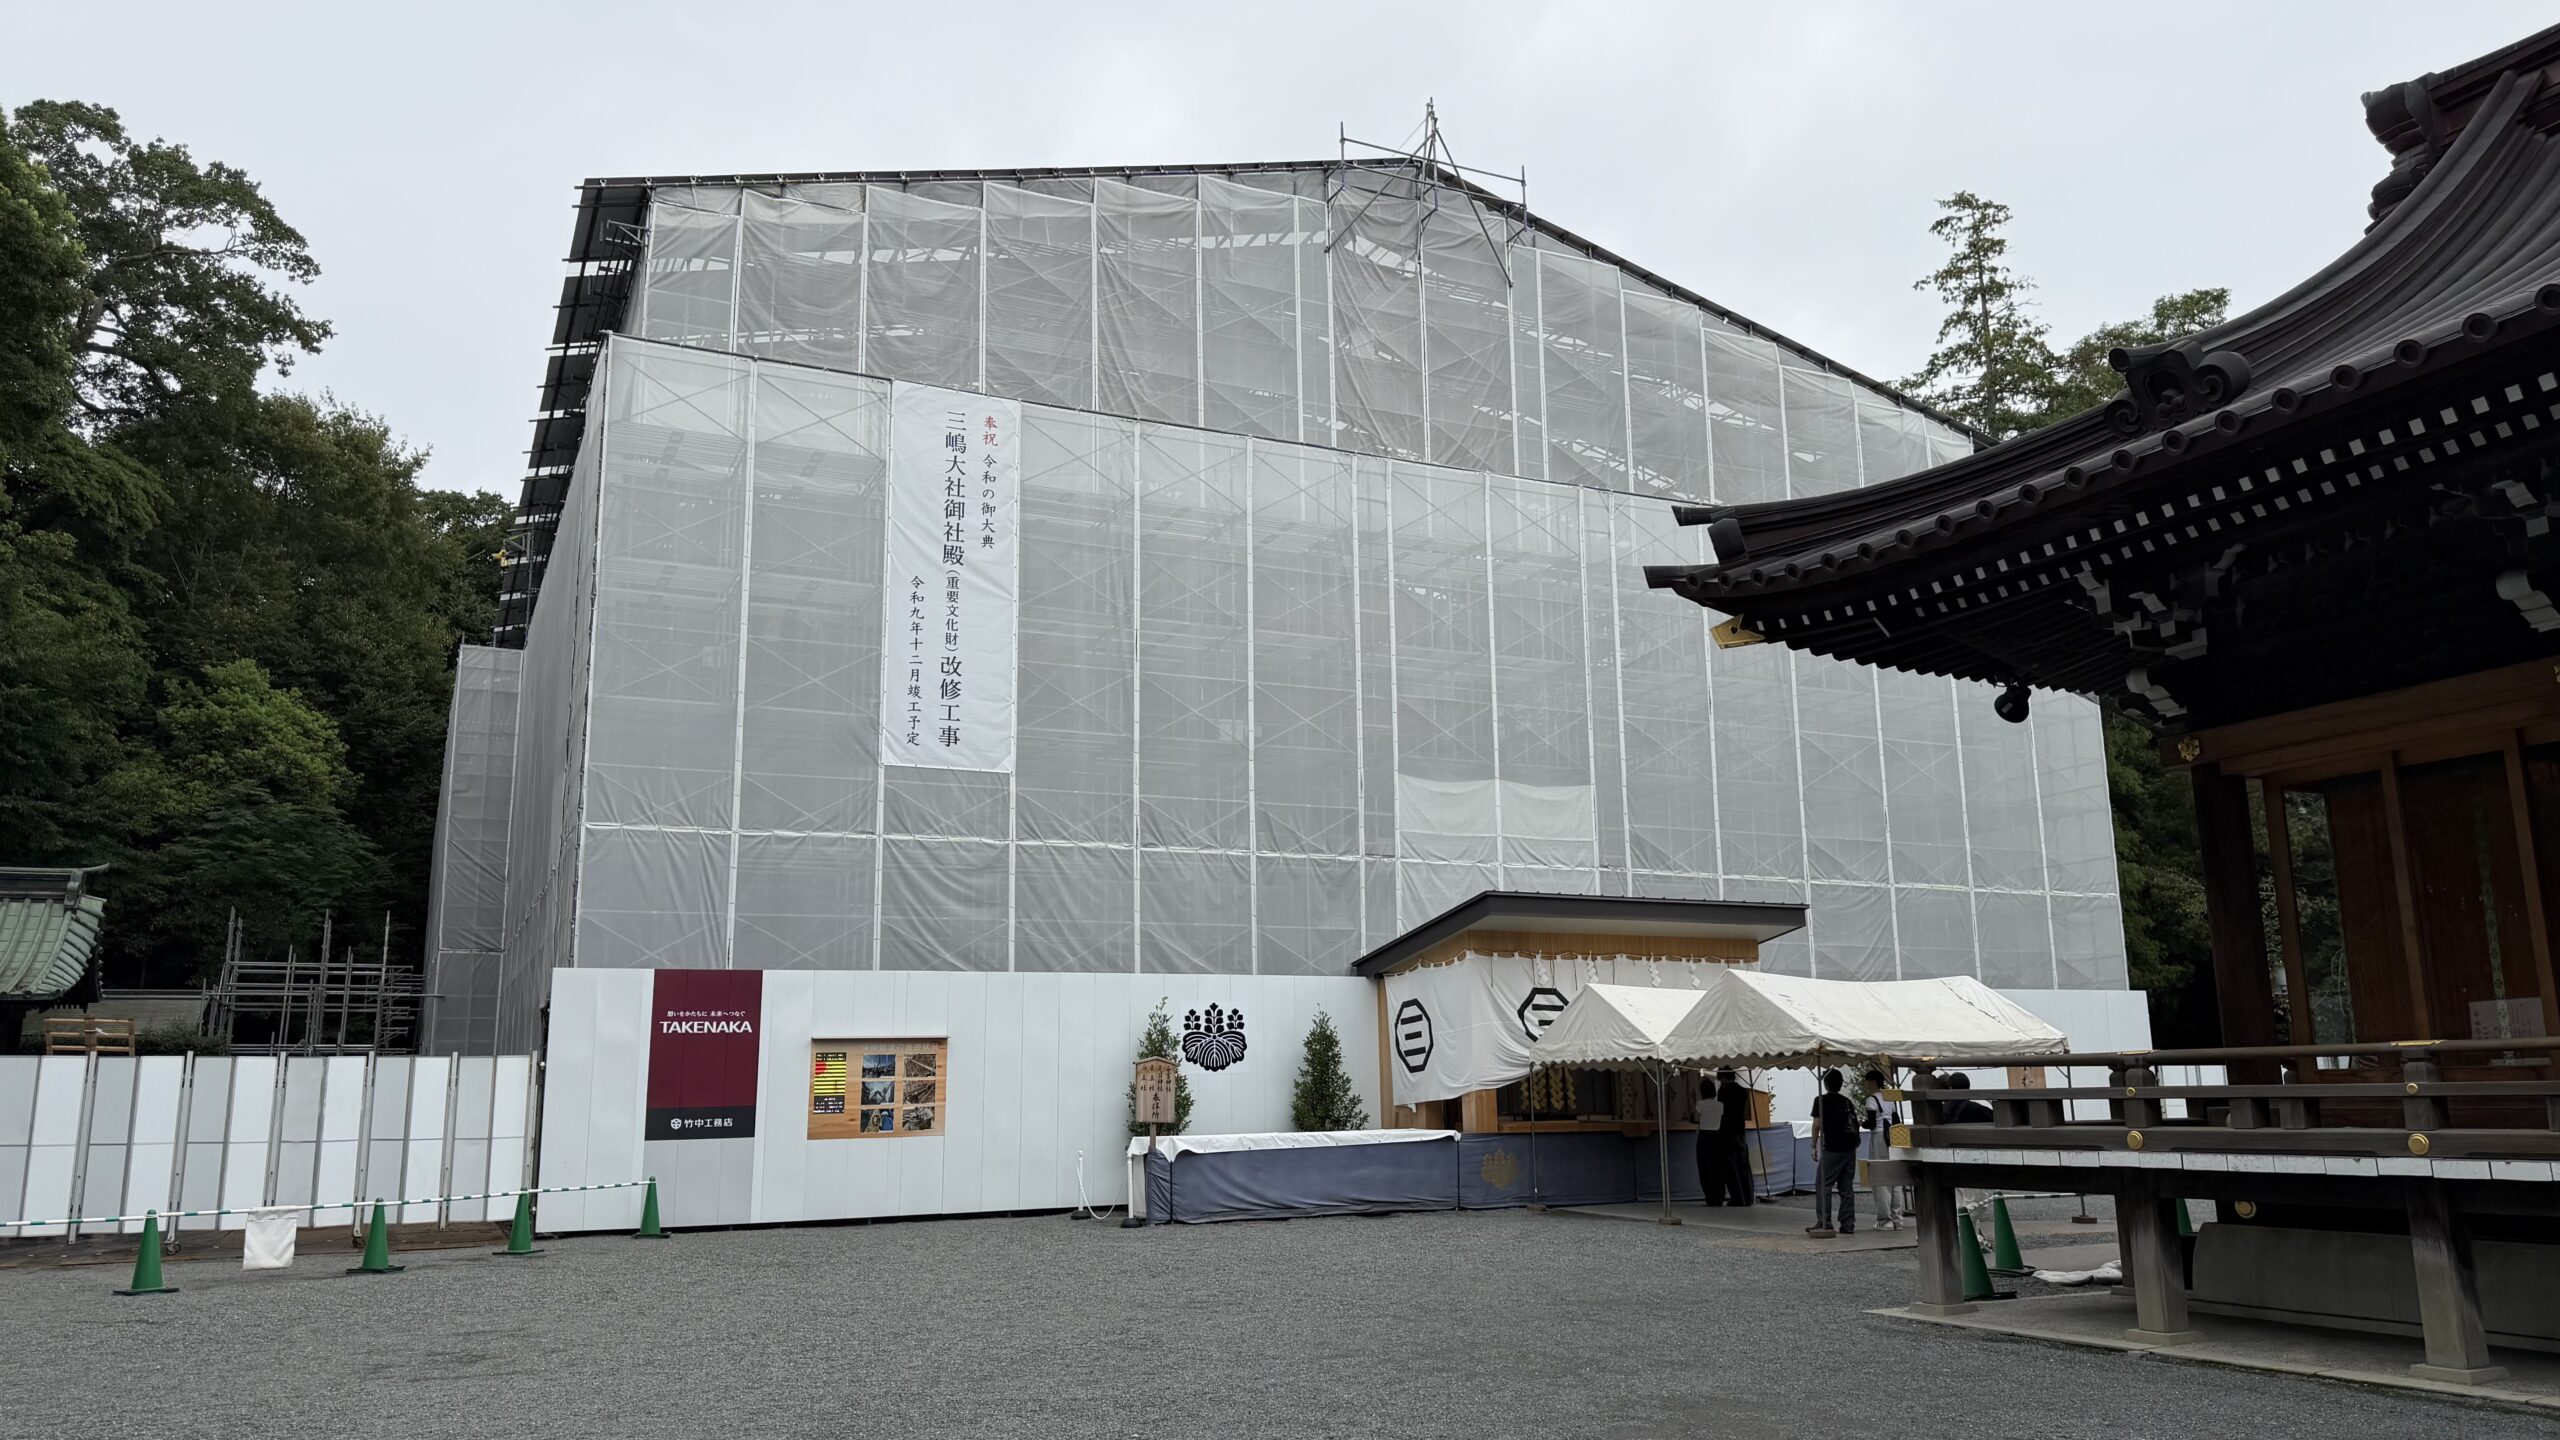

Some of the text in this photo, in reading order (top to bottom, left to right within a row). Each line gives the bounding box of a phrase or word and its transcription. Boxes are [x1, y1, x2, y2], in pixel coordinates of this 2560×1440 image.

[980, 415, 999, 550] 奉祝 令和の御大典
[906, 575, 925, 747] 令和九年十二月竣工予定
[659, 1021, 752, 1033] TAKENAKA
[684, 1118, 733, 1128] 竹中工務店
